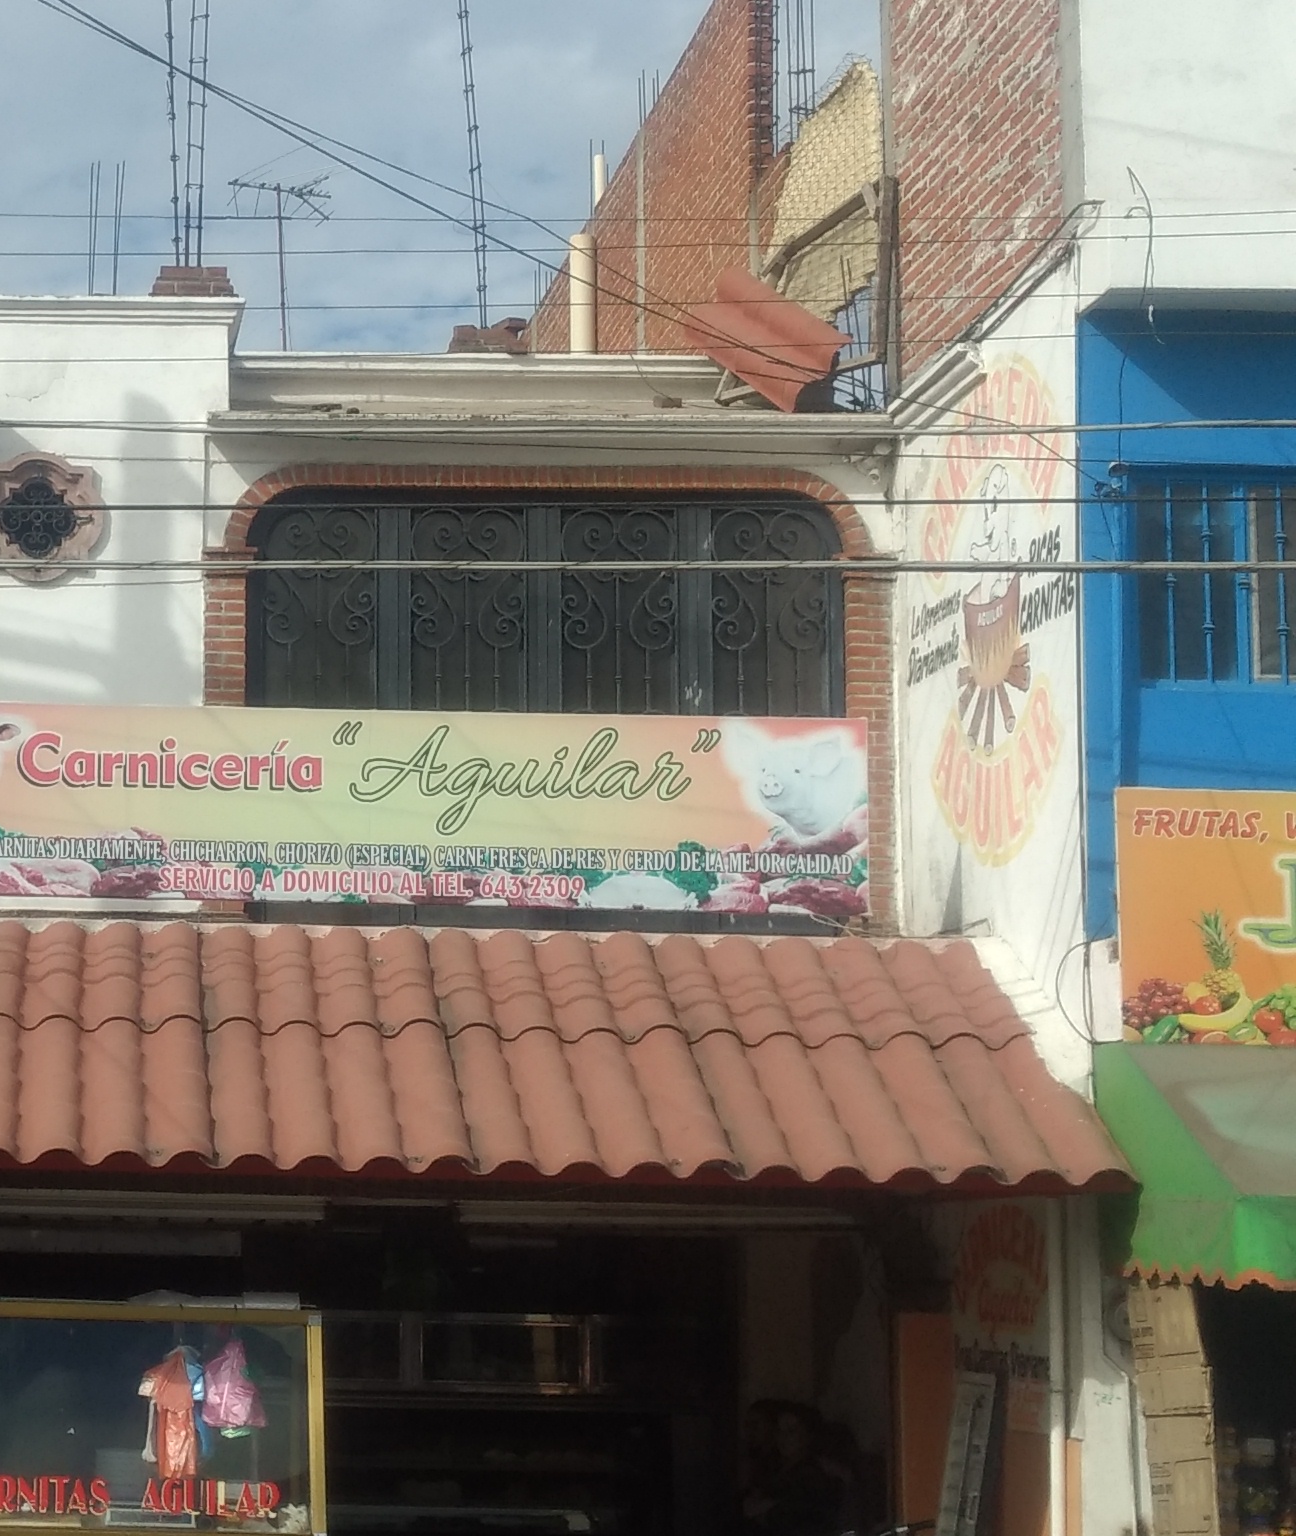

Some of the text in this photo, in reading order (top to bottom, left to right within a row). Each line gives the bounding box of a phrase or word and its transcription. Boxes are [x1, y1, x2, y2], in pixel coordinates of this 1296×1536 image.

[1028, 525, 1061, 578] RICAS
[1020, 572, 1075, 635] CARNITAS
[15, 733, 323, 794] Carnicería
[936, 685, 1058, 853] AGUILAR
[1133, 808, 1269, 844] FRUTAS,
[59, 838, 165, 863] DIARIAMENTE,
[170, 841, 271, 865] CHICHARRON,
[275, 842, 341, 865] CHORIZO
[345, 843, 430, 867] (ESPECIAL)
[434, 847, 485, 868] CARNE
[488, 847, 548, 869] FRESCA
[550, 848, 575, 870] DE
[577, 848, 604, 870] RES
[609, 849, 621, 871] Y
[623, 849, 676, 872] CERDO
[680, 850, 703, 872] DE
[705, 851, 725, 873] LA
[728, 852, 782, 873] MEJOR
[784, 853, 853, 875] CALIDAD
[159, 868, 586, 899] SERVICIO A DOMICILIO AL TEL. 643 2309
[141, 1477, 281, 1519] AGUILAR
